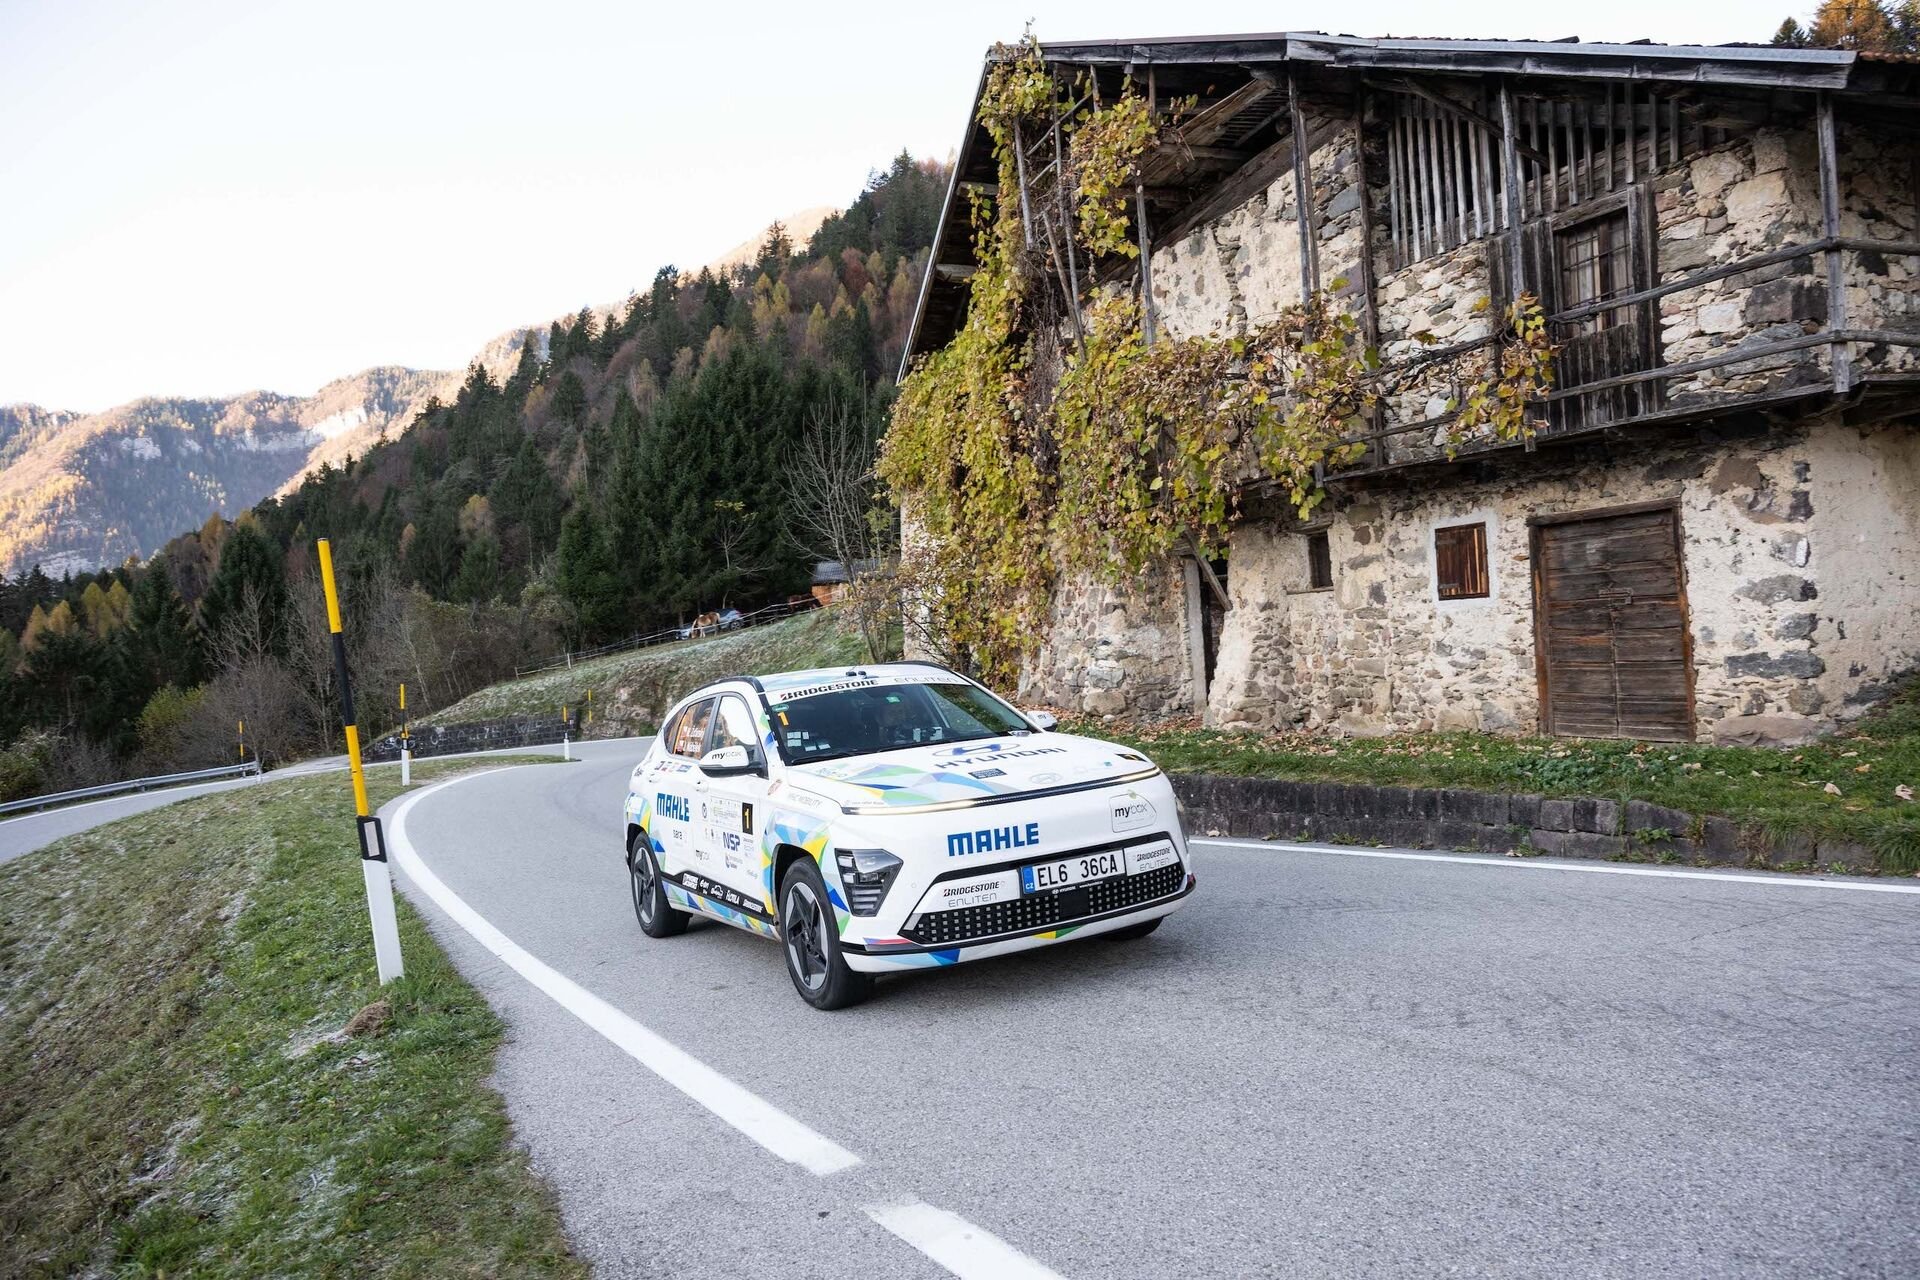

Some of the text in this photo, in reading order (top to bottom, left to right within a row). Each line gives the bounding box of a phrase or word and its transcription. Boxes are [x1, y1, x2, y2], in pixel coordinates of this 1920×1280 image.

[780, 679, 879, 701] BRIDGESTONE
[777, 711, 789, 726] 1
[934, 747, 1068, 769] HYUNDAI
[656, 792, 690, 822] MAHLE
[744, 808, 750, 829] 1
[722, 831, 741, 852] NSP
[947, 822, 1040, 857] MAHLE
[1136, 846, 1171, 862] BRIDGESTONE
[1037, 854, 1118, 887] EL6 36CA
[943, 880, 1000, 897] BRIDGESTONE
[1025, 882, 1034, 890] CZ
[948, 892, 997, 908] ENLITEN
